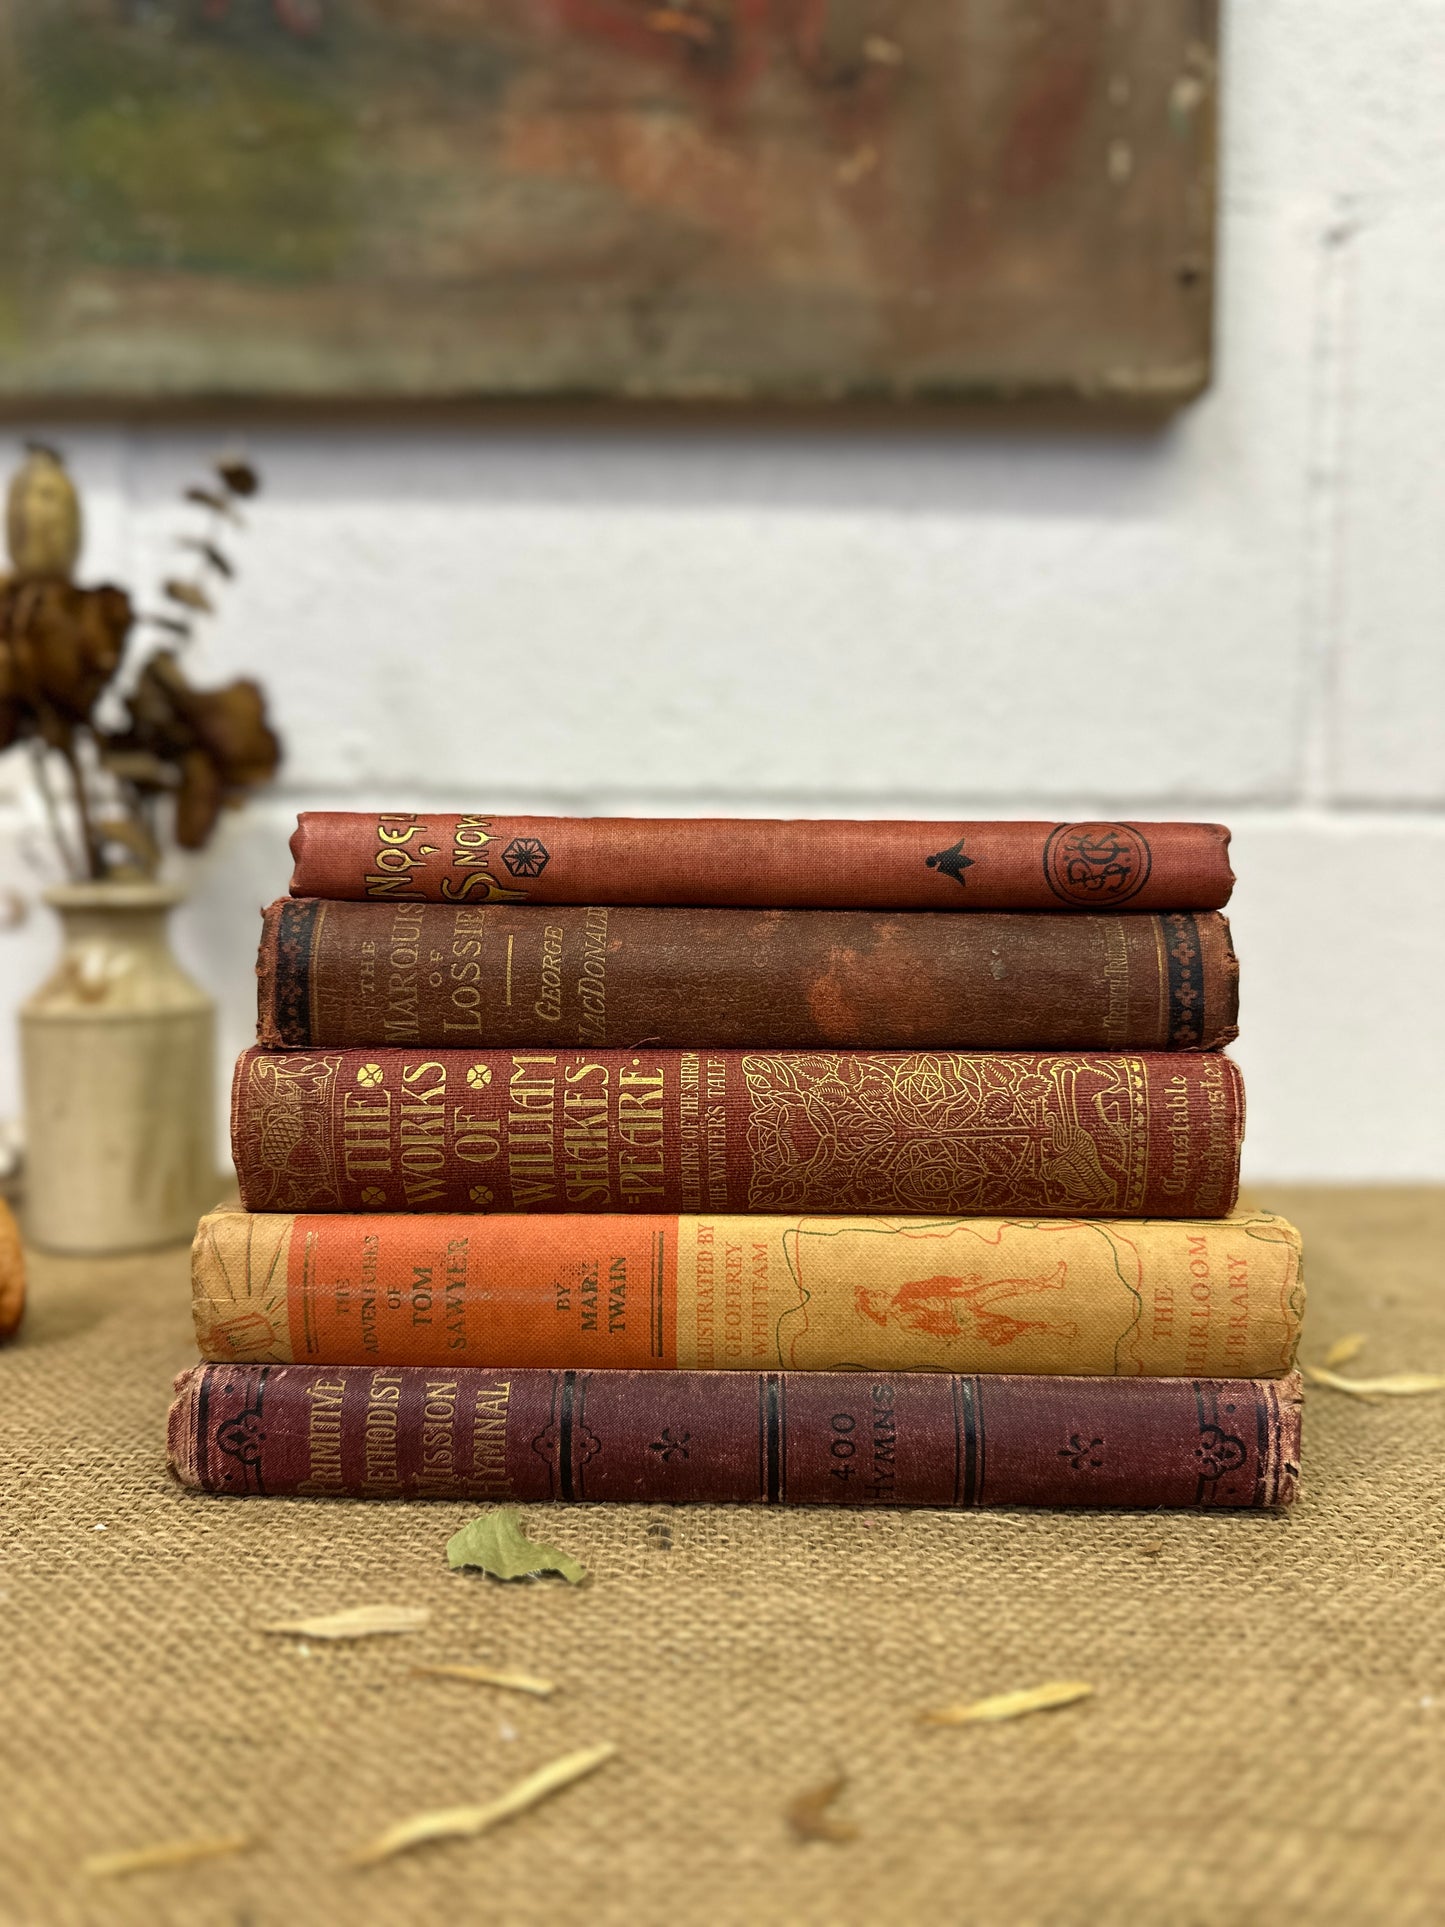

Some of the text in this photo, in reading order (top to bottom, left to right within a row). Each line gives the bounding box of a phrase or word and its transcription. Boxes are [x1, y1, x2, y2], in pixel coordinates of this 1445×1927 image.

[361, 940, 376, 994] THE
[384, 902, 425, 1042] MARQUIS
[429, 949, 443, 988] OF
[443, 908, 484, 1034] LOSSIE
[535, 926, 564, 1022] GEORGE
[680, 1053, 700, 1091] SHREW
[680, 1092, 700, 1117] THE
[344, 1089, 392, 1182] THE
[399, 1061, 448, 1206] WORKS
[454, 1105, 501, 1163] OF
[508, 1055, 557, 1206] WILLIAM
[680, 1121, 700, 1139] OF
[680, 1142, 700, 1191] TAMING
[705, 1106, 727, 1180] WINTER'S
[1160, 1074, 1191, 1195] Constable
[336, 1279, 350, 1316] THE
[361, 1234, 379, 1354] ADVENTURES
[387, 1284, 401, 1310] OF
[412, 1267, 433, 1328] TOM
[446, 1238, 469, 1350] SAWYER
[556, 1282, 571, 1311] BY
[608, 1257, 626, 1334] TWAIN
[697, 1223, 714, 1369] ILLUSTRATED BY
[725, 1241, 742, 1358] GEOFFREY
[752, 1243, 769, 1358] WHITTAM
[1152, 1287, 1174, 1341] THE
[1222, 1254, 1248, 1369] LIBRARY
[297, 1376, 348, 1496] PRIMITIVE
[463, 1381, 514, 1497] HYMNAL
[829, 1412, 856, 1482] 400
